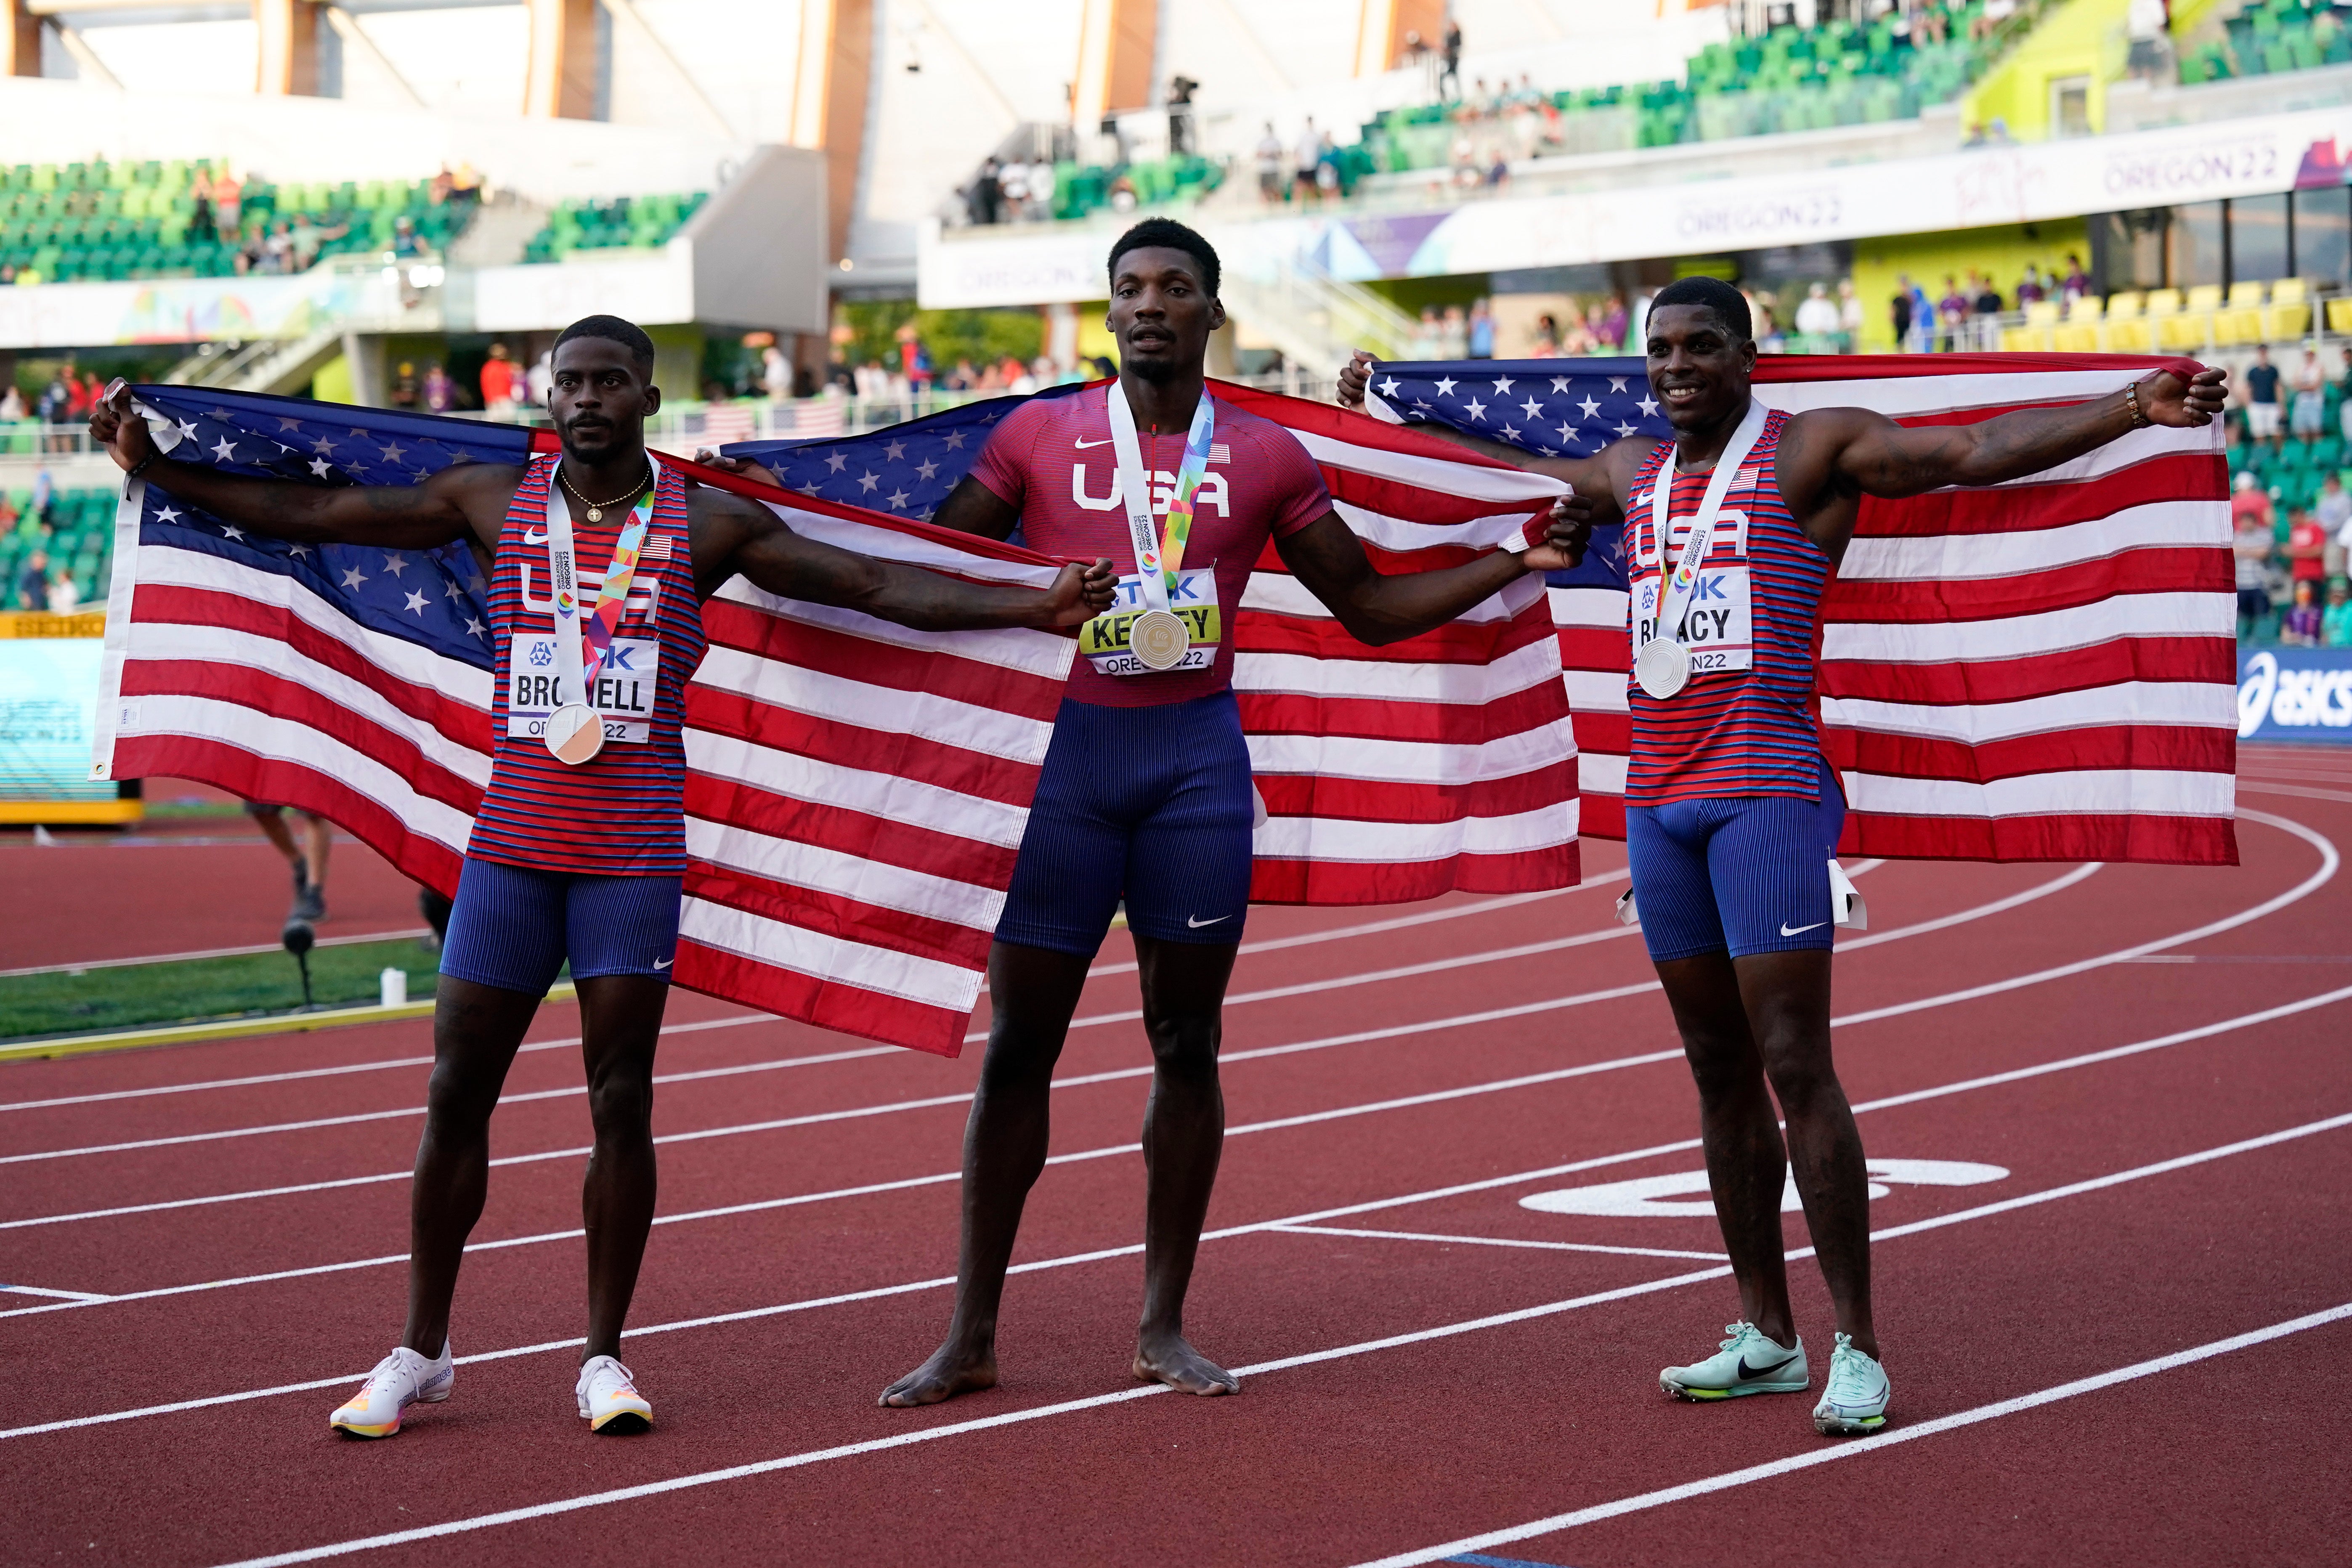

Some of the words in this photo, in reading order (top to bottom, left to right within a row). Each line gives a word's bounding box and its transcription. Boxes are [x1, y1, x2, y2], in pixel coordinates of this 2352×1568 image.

[1072, 463, 1230, 517] USA
[1635, 509, 1749, 568] USA
[520, 563, 661, 624] USA
[1118, 577, 1199, 604] TK
[1641, 609, 1731, 647] BACY
[517, 675, 645, 712] BROELL
